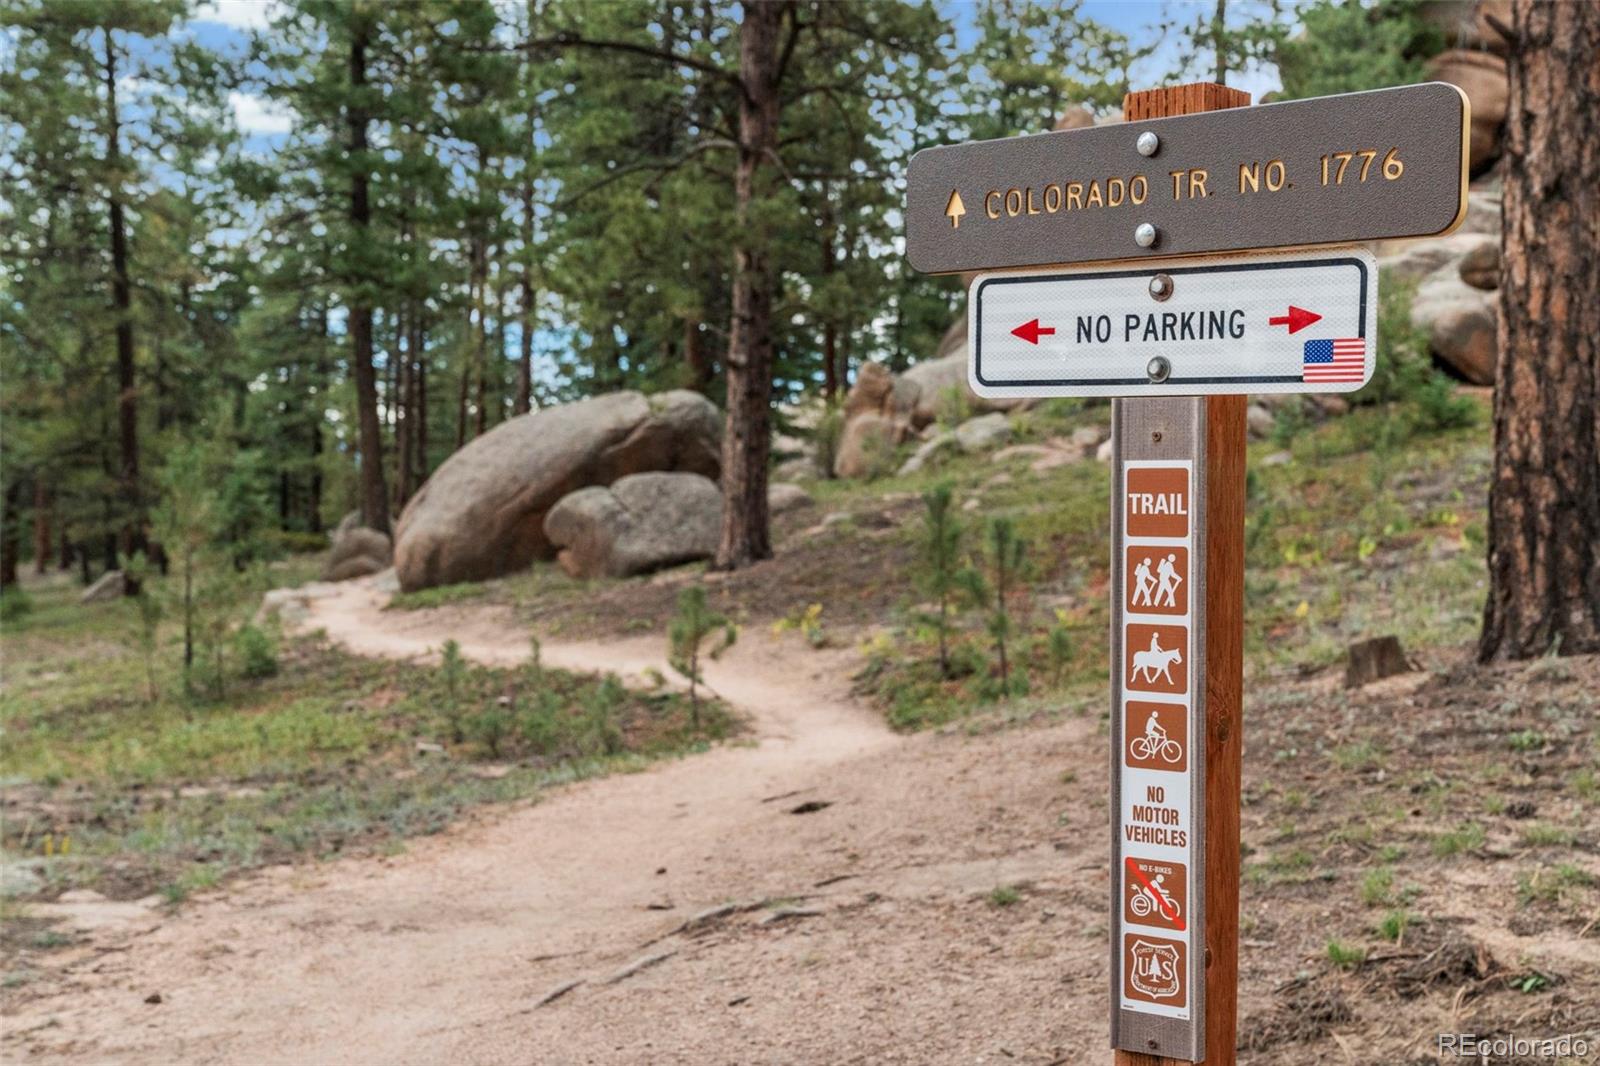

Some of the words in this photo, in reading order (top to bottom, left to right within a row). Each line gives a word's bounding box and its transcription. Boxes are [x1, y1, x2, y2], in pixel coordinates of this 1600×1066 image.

[985, 174, 1149, 220] COLORADO
[1169, 168, 1214, 200] TR.
[1239, 159, 1293, 194] NO.
[1319, 147, 1405, 186] 1776
[1076, 315, 1112, 344] NO
[1125, 309, 1246, 342] PARKING
[1128, 493, 1187, 515] TRAIL
[1147, 785, 1165, 803] NO
[1132, 805, 1179, 825] MOTOR
[1125, 824, 1187, 848] VEHICLES
[1139, 864, 1148, 872] NO
[1149, 866, 1172, 875] E-BIKES
